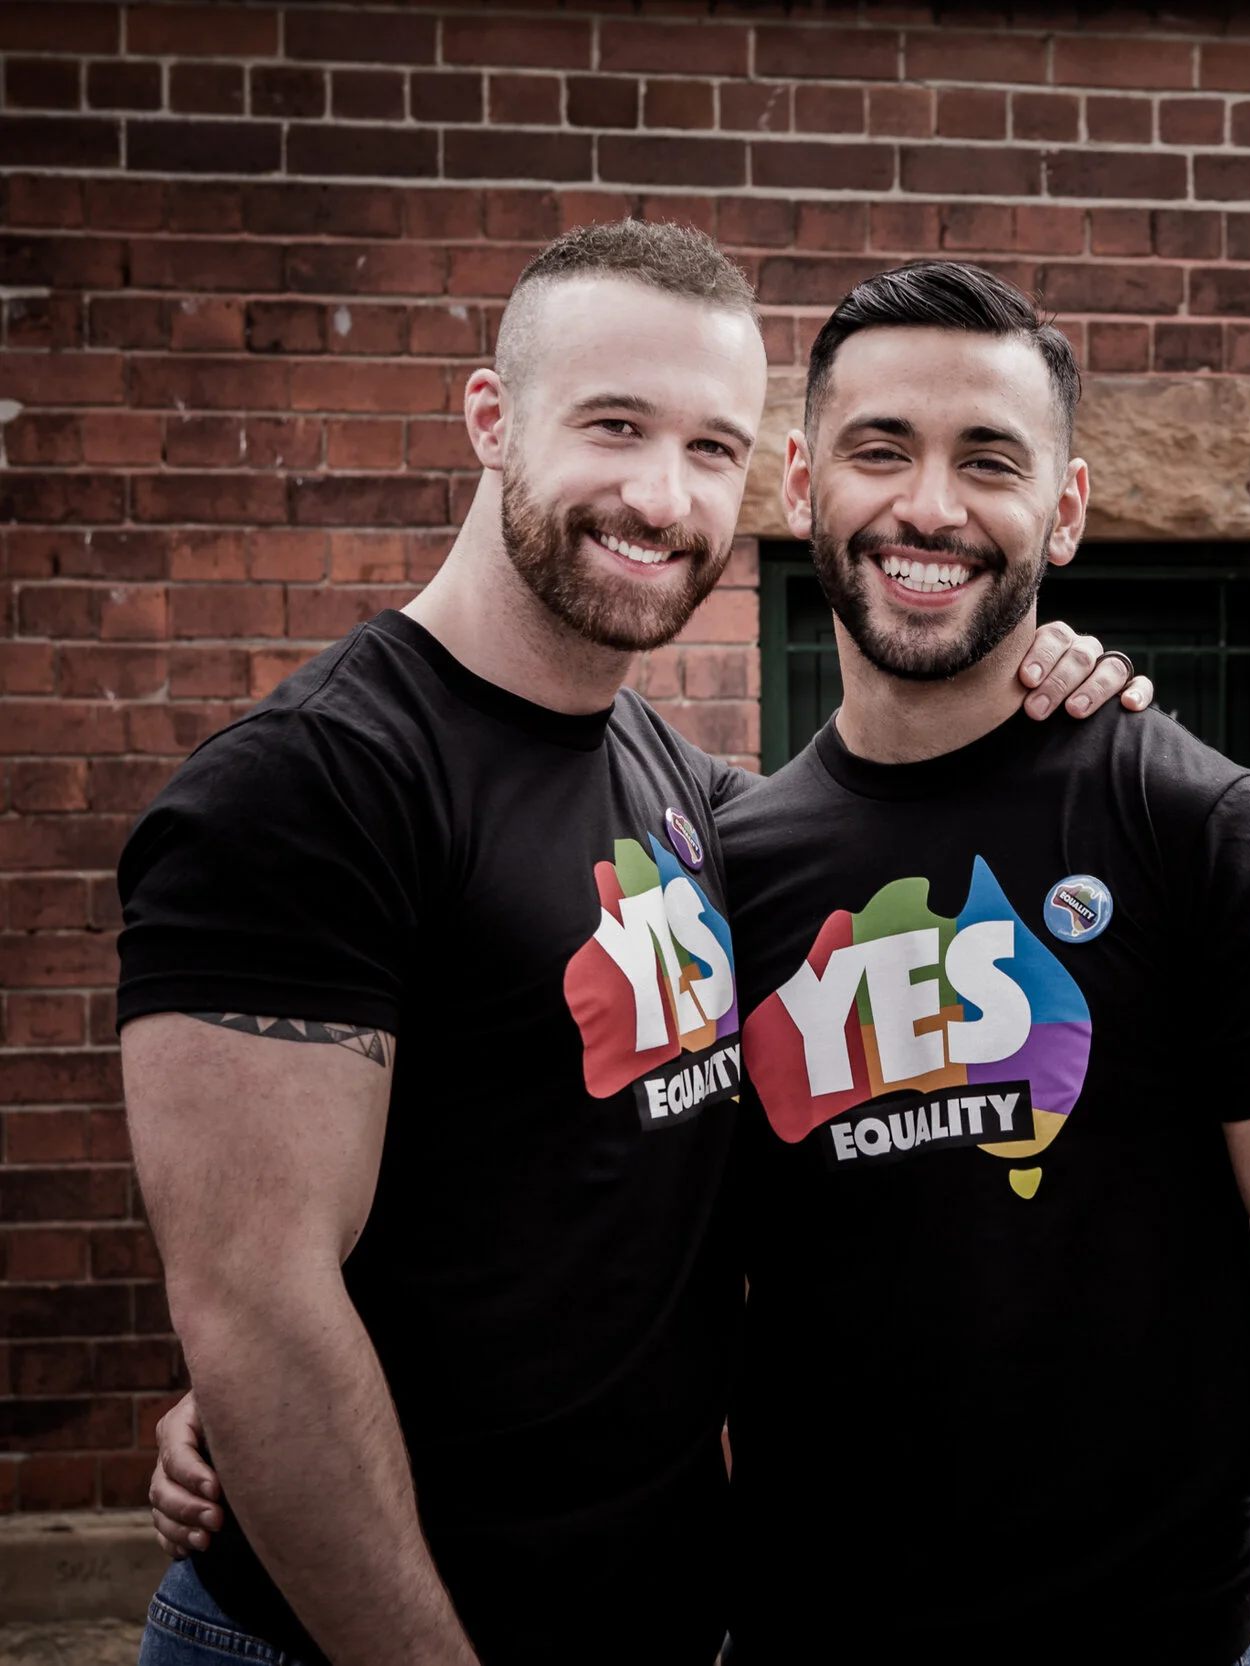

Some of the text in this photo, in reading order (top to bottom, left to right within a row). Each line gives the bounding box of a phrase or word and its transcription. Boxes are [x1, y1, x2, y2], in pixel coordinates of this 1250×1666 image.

[1059, 891, 1095, 920] EQUALITY
[776, 920, 1031, 1097] YES
[830, 1093, 1021, 1161] EQUALITY
